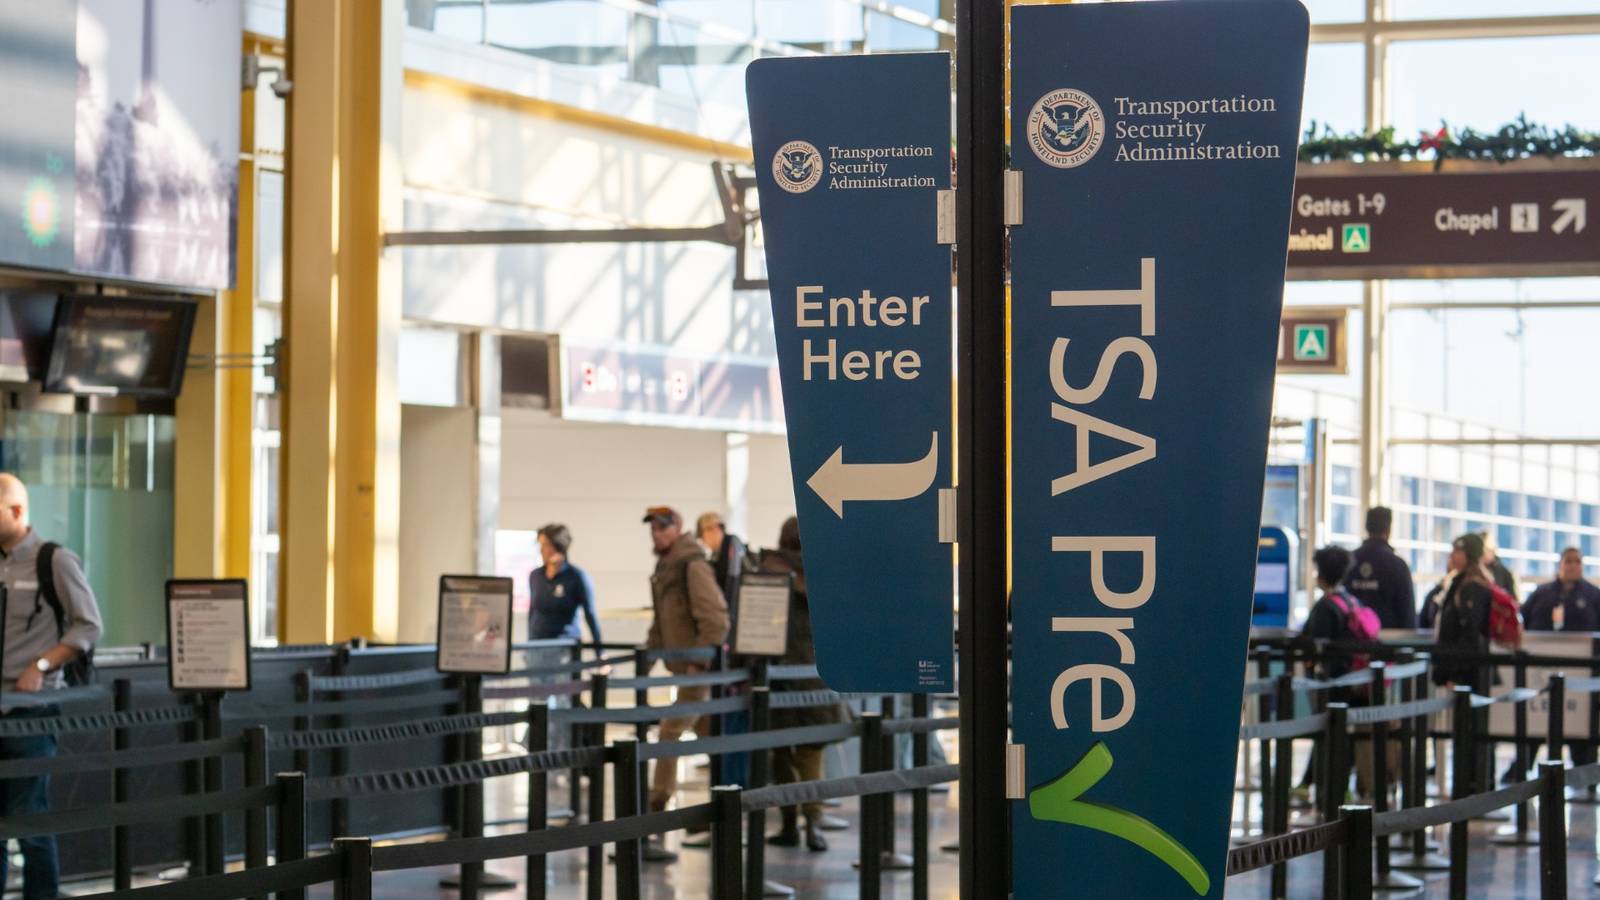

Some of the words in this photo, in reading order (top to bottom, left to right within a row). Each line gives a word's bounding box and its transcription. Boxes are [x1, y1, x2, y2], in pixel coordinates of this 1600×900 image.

[1042, 92, 1097, 111] DEPARTMENT
[1114, 95, 1277, 120] Transportation
[1115, 120, 1207, 143] Security
[828, 145, 933, 162] Transportation
[1031, 132, 1068, 165] HOMELAND
[1070, 131, 1101, 164] SECURITY
[1114, 141, 1281, 162] Administration
[829, 161, 889, 177] Security
[828, 175, 937, 190] Administration
[1297, 194, 1351, 218] Gates
[1357, 192, 1387, 216] 1-9
[1434, 207, 1499, 236] Chapel
[1288, 226, 1334, 251] minal
[1345, 227, 1367, 252] A
[796, 285, 930, 328] Enter
[1298, 328, 1327, 358] A
[803, 339, 922, 381] Here
[1050, 257, 1158, 497] TSA
[1050, 536, 1156, 733] Pre
